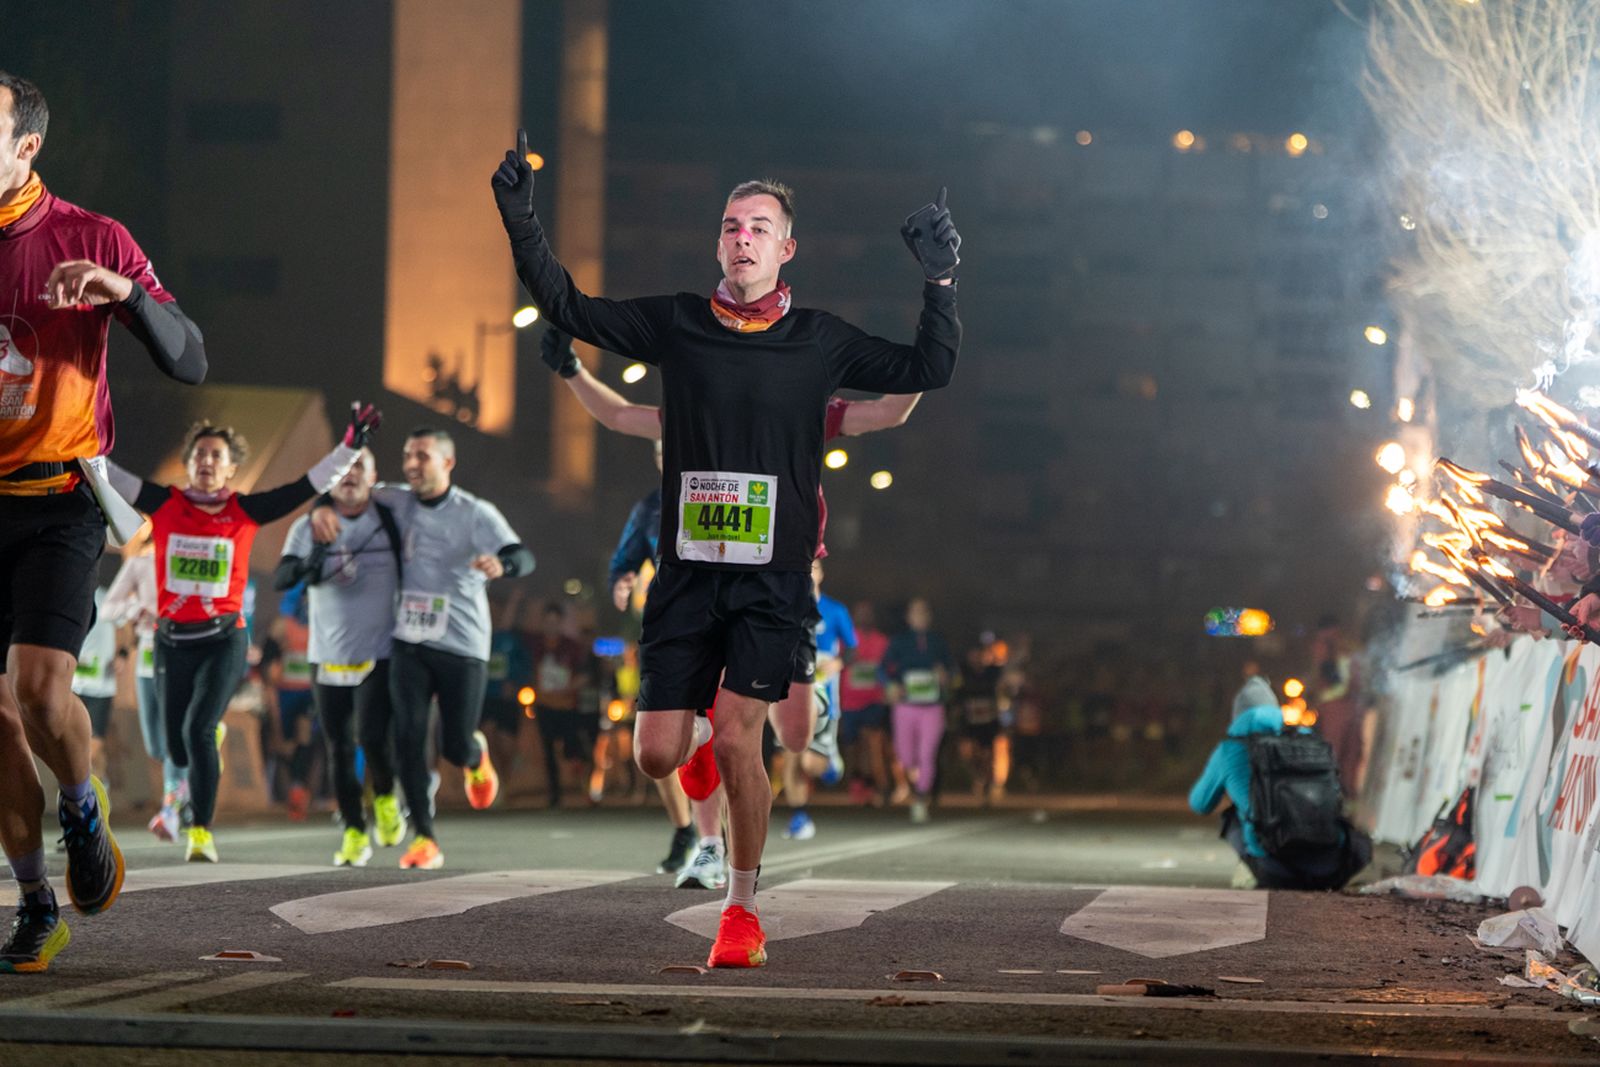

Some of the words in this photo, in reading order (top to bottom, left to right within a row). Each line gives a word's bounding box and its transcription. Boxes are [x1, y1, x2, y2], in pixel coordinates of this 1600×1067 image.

[700, 482, 727, 491] NOCHE
[728, 483, 739, 492] DE
[690, 493, 708, 502] SAN
[709, 492, 739, 503] ANTÓN
[697, 504, 752, 532] 4441
[178, 557, 220, 577] 2280
